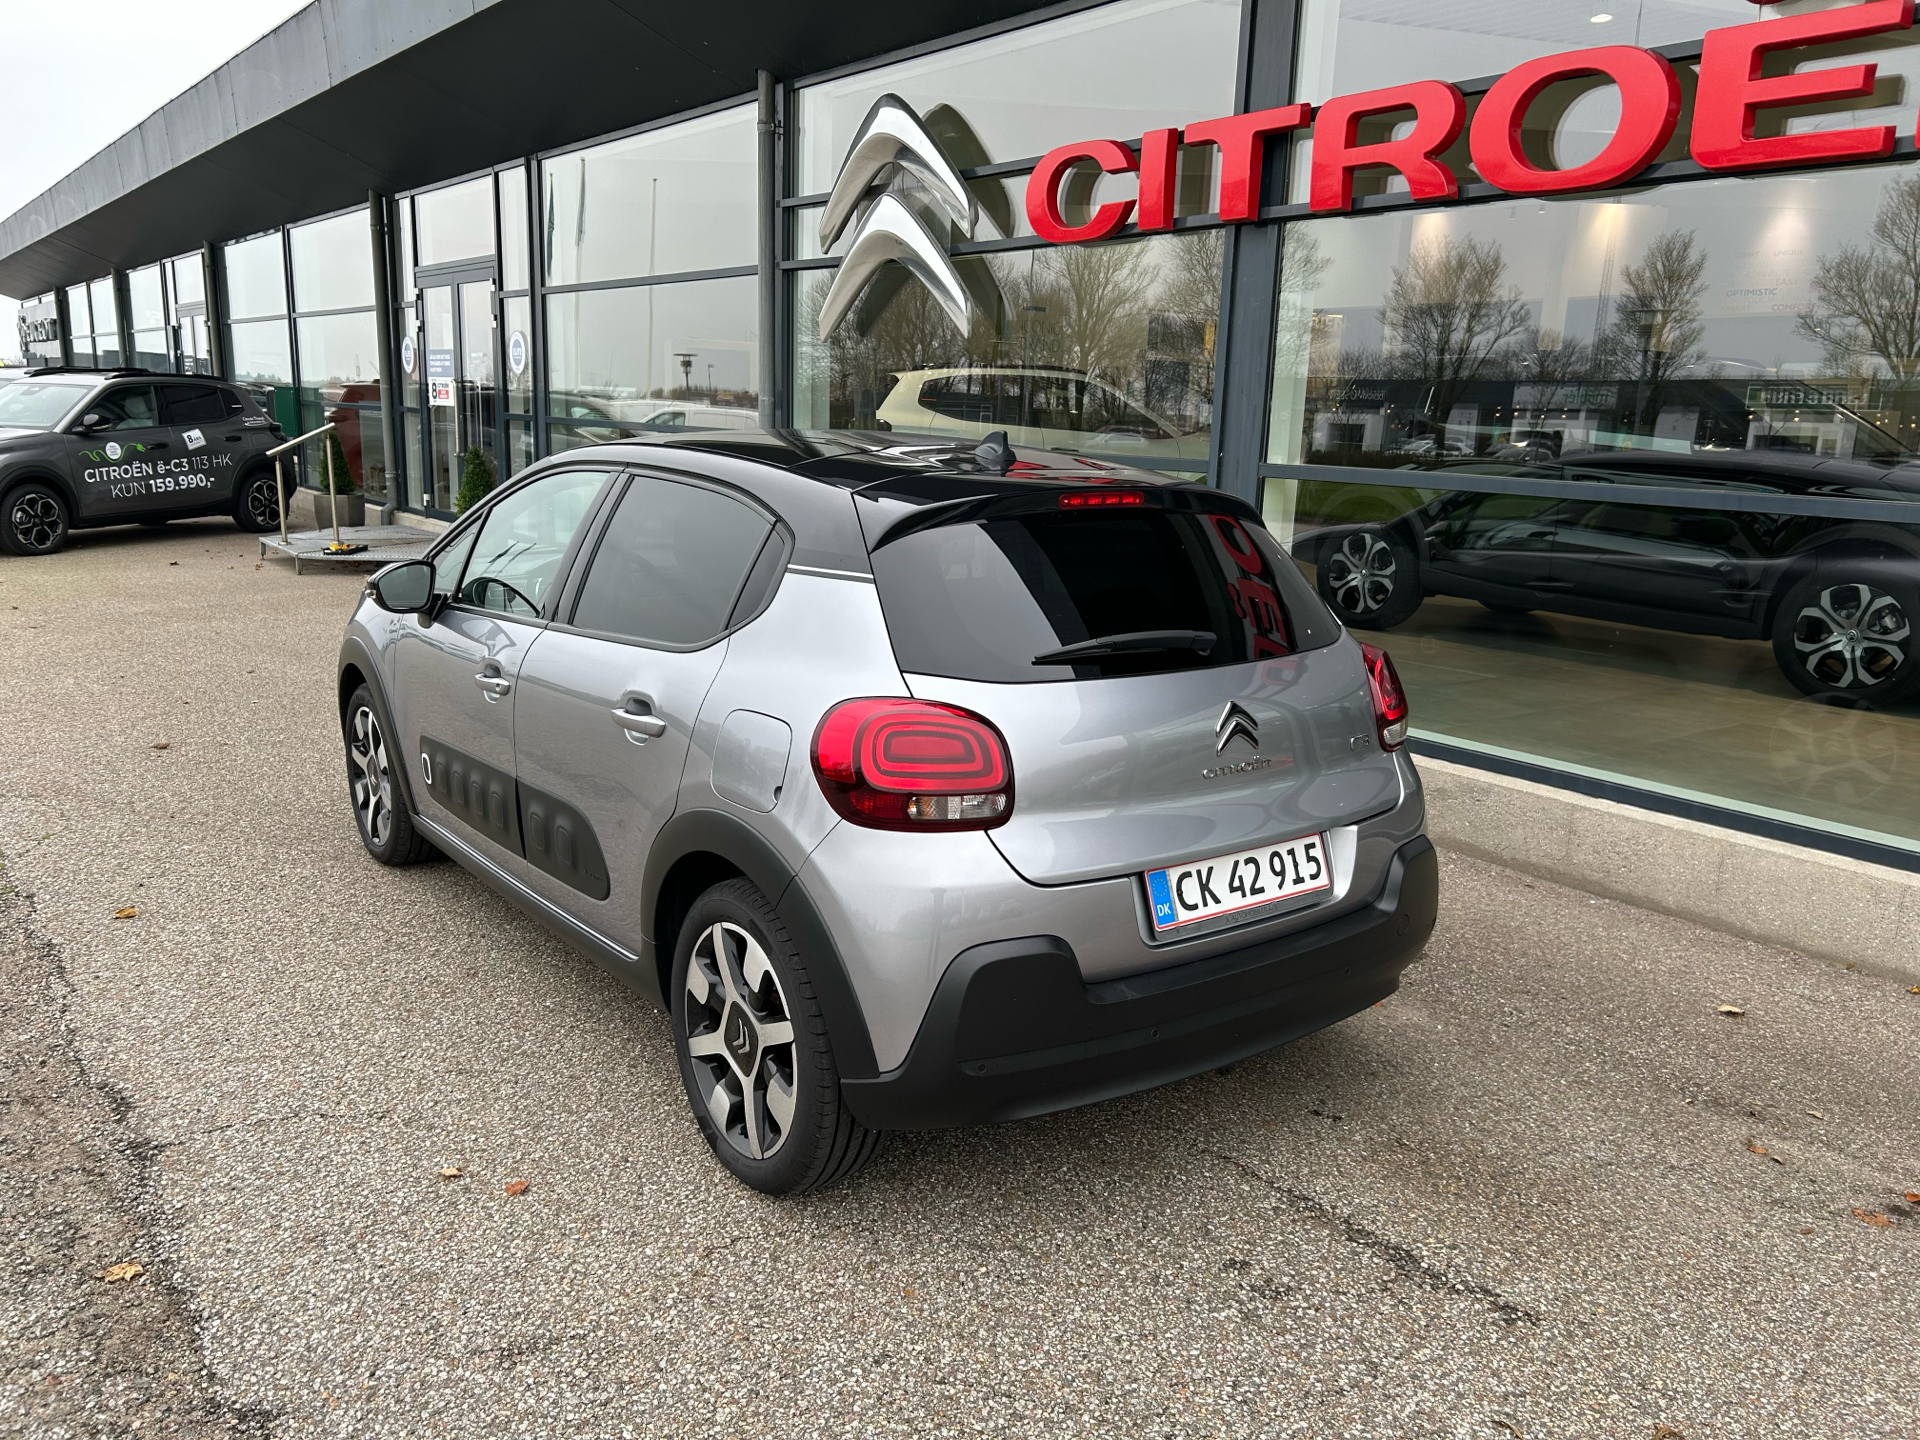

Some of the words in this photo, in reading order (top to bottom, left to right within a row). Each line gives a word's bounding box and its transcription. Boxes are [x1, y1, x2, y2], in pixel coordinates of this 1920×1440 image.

[1026, 0, 1920, 246] CITROË
[1726, 287, 1778, 297] OPTIMISTIC
[1021, 319, 1061, 336] ICONIC
[1020, 336, 1060, 353] BRAND
[431, 382, 438, 400] 8
[186, 434, 194, 444] 8
[84, 461, 153, 483] CITROËN
[157, 457, 189, 474] ë-C3
[191, 456, 210, 471] 113
[212, 453, 233, 468] HK
[110, 481, 146, 499] KUN
[149, 473, 215, 493] 159.990,-
[1350, 732, 1370, 752] C3
[1176, 865, 1222, 912] CK
[1228, 856, 1265, 899] 42
[1269, 842, 1322, 891] 915
[1156, 902, 1172, 917] DK
